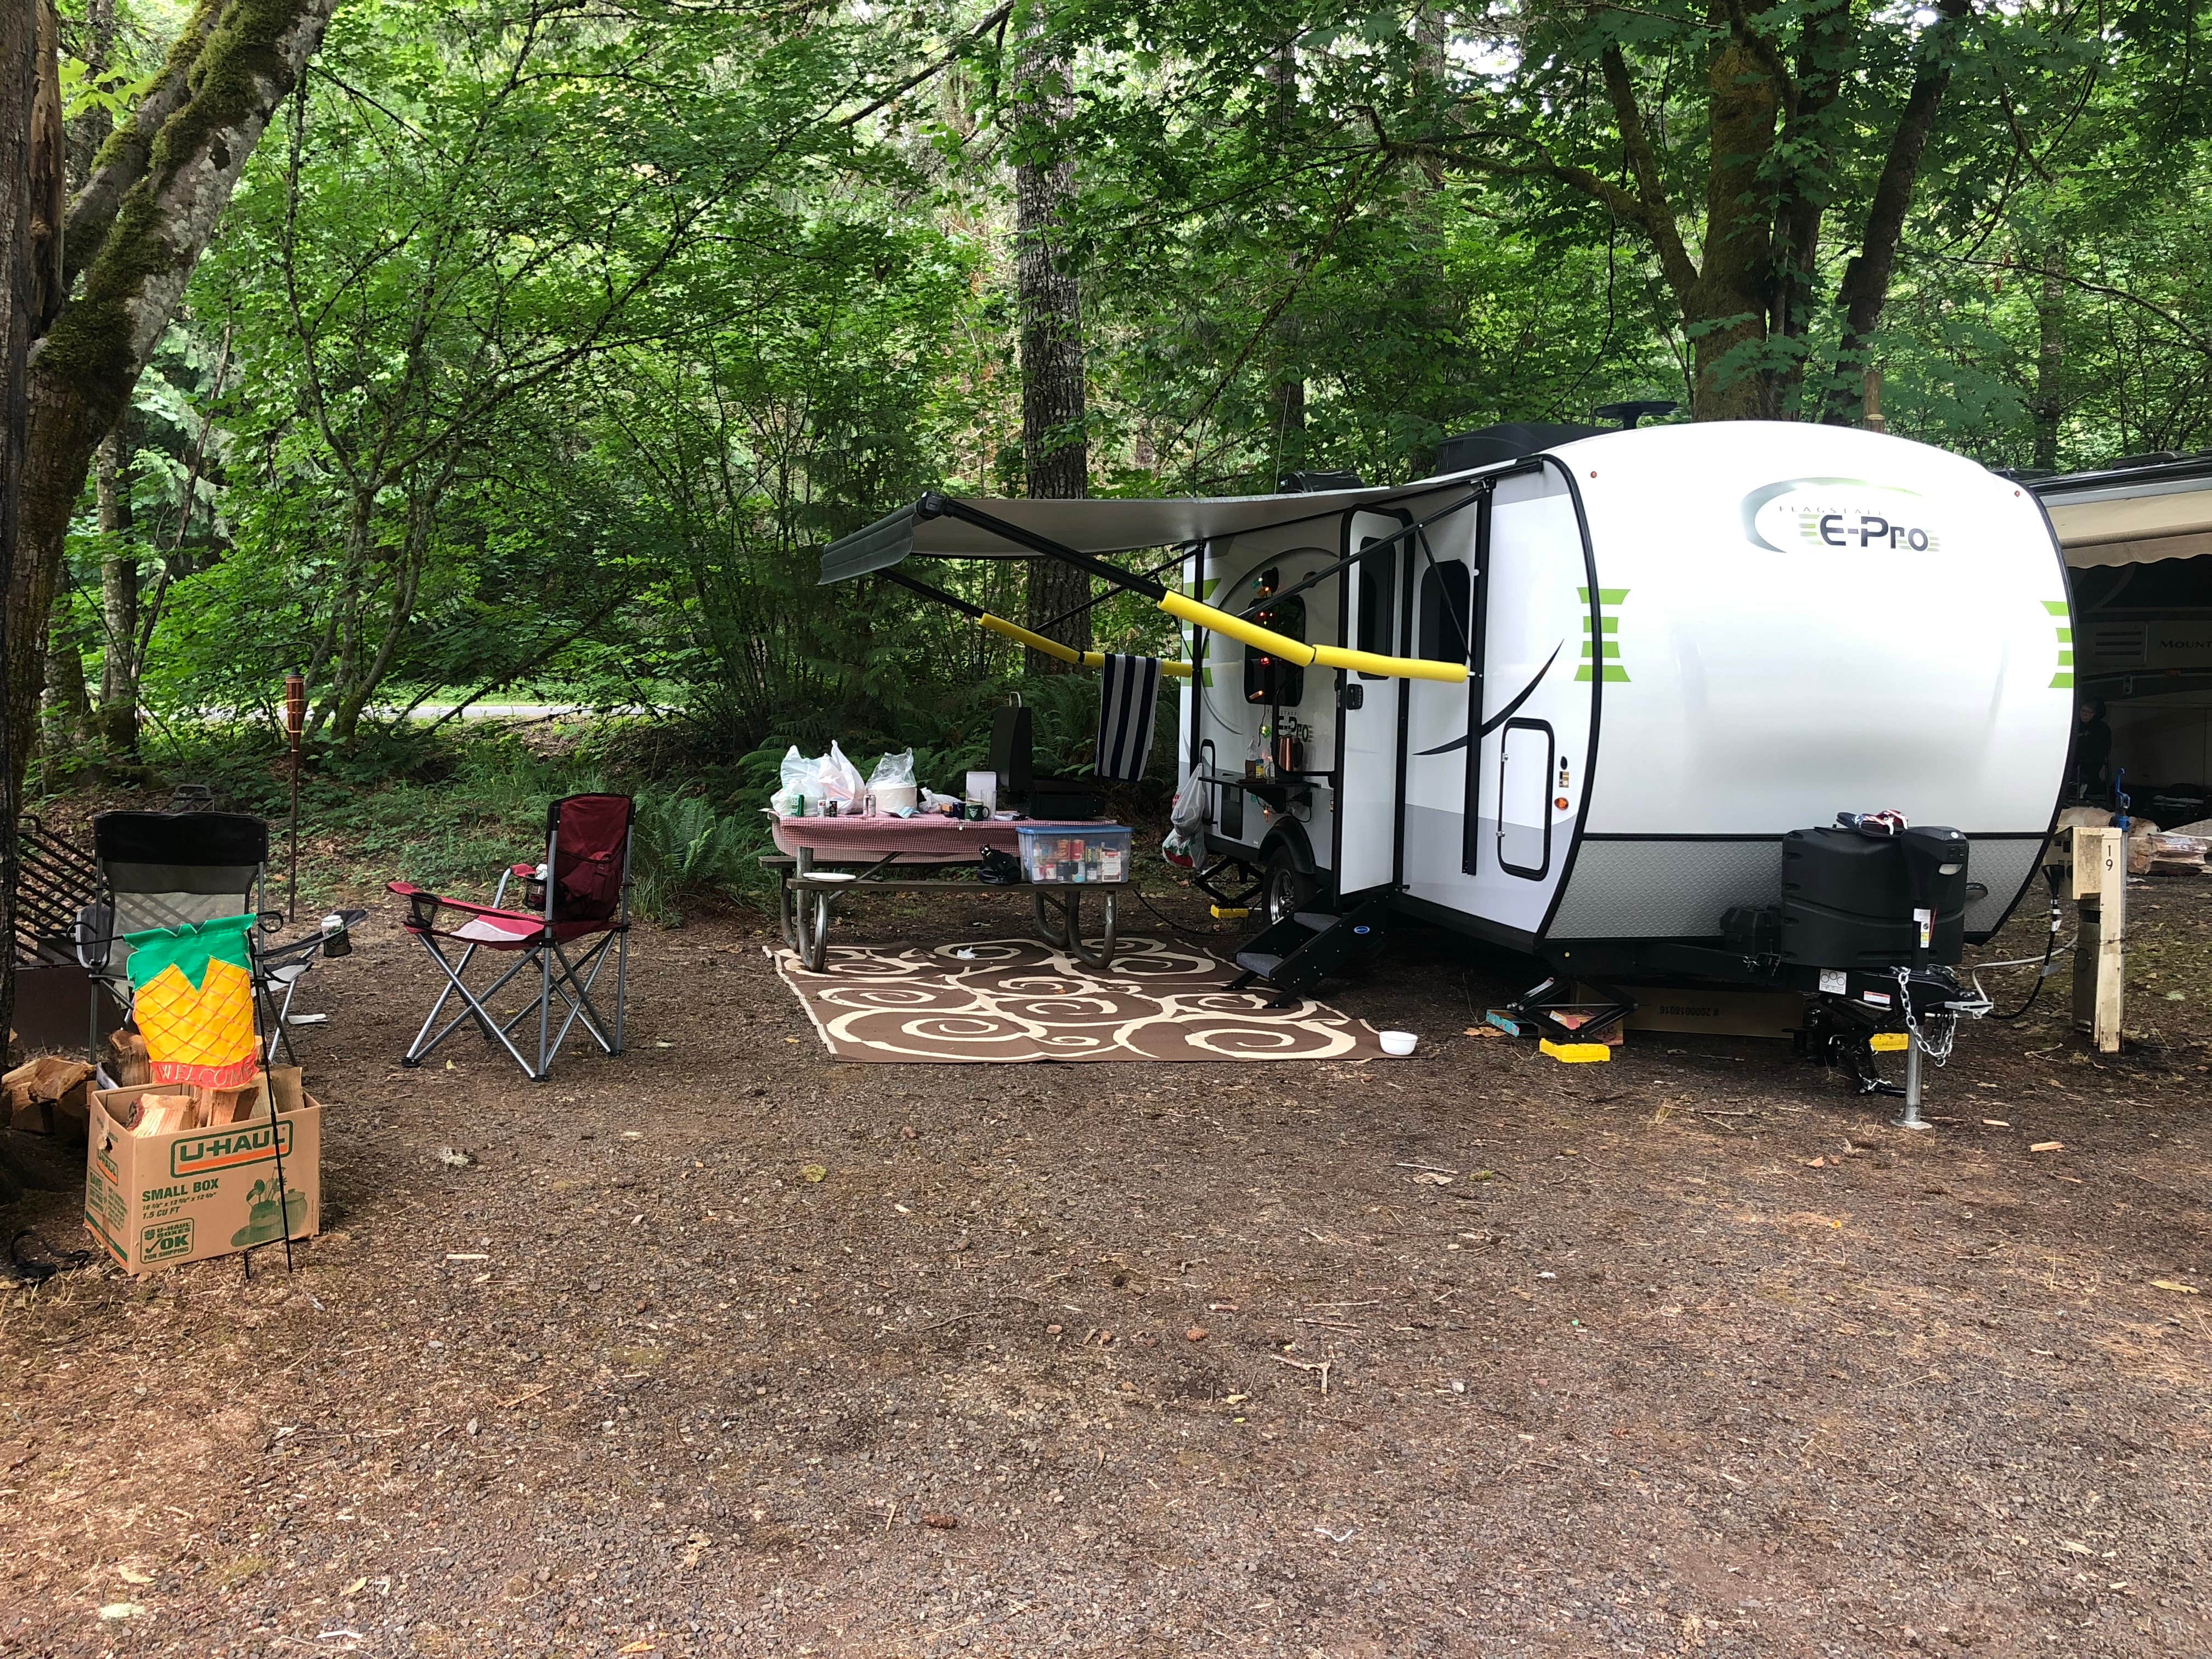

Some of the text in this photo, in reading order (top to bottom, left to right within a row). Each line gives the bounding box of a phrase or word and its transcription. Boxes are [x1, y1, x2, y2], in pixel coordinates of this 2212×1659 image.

[1820, 514, 1928, 551] E-Pro
[157, 1062, 253, 1086] WELCOME
[180, 1128, 285, 1161] U-HAUL
[142, 1178, 219, 1202] SMALL BOX
[143, 1206, 180, 1220] 1.5 CU FT
[157, 1222, 190, 1233] U-HAUL
[157, 1227, 190, 1238] BOXES
[160, 1234, 189, 1250] OK
[159, 1246, 189, 1257] SHIPPING
